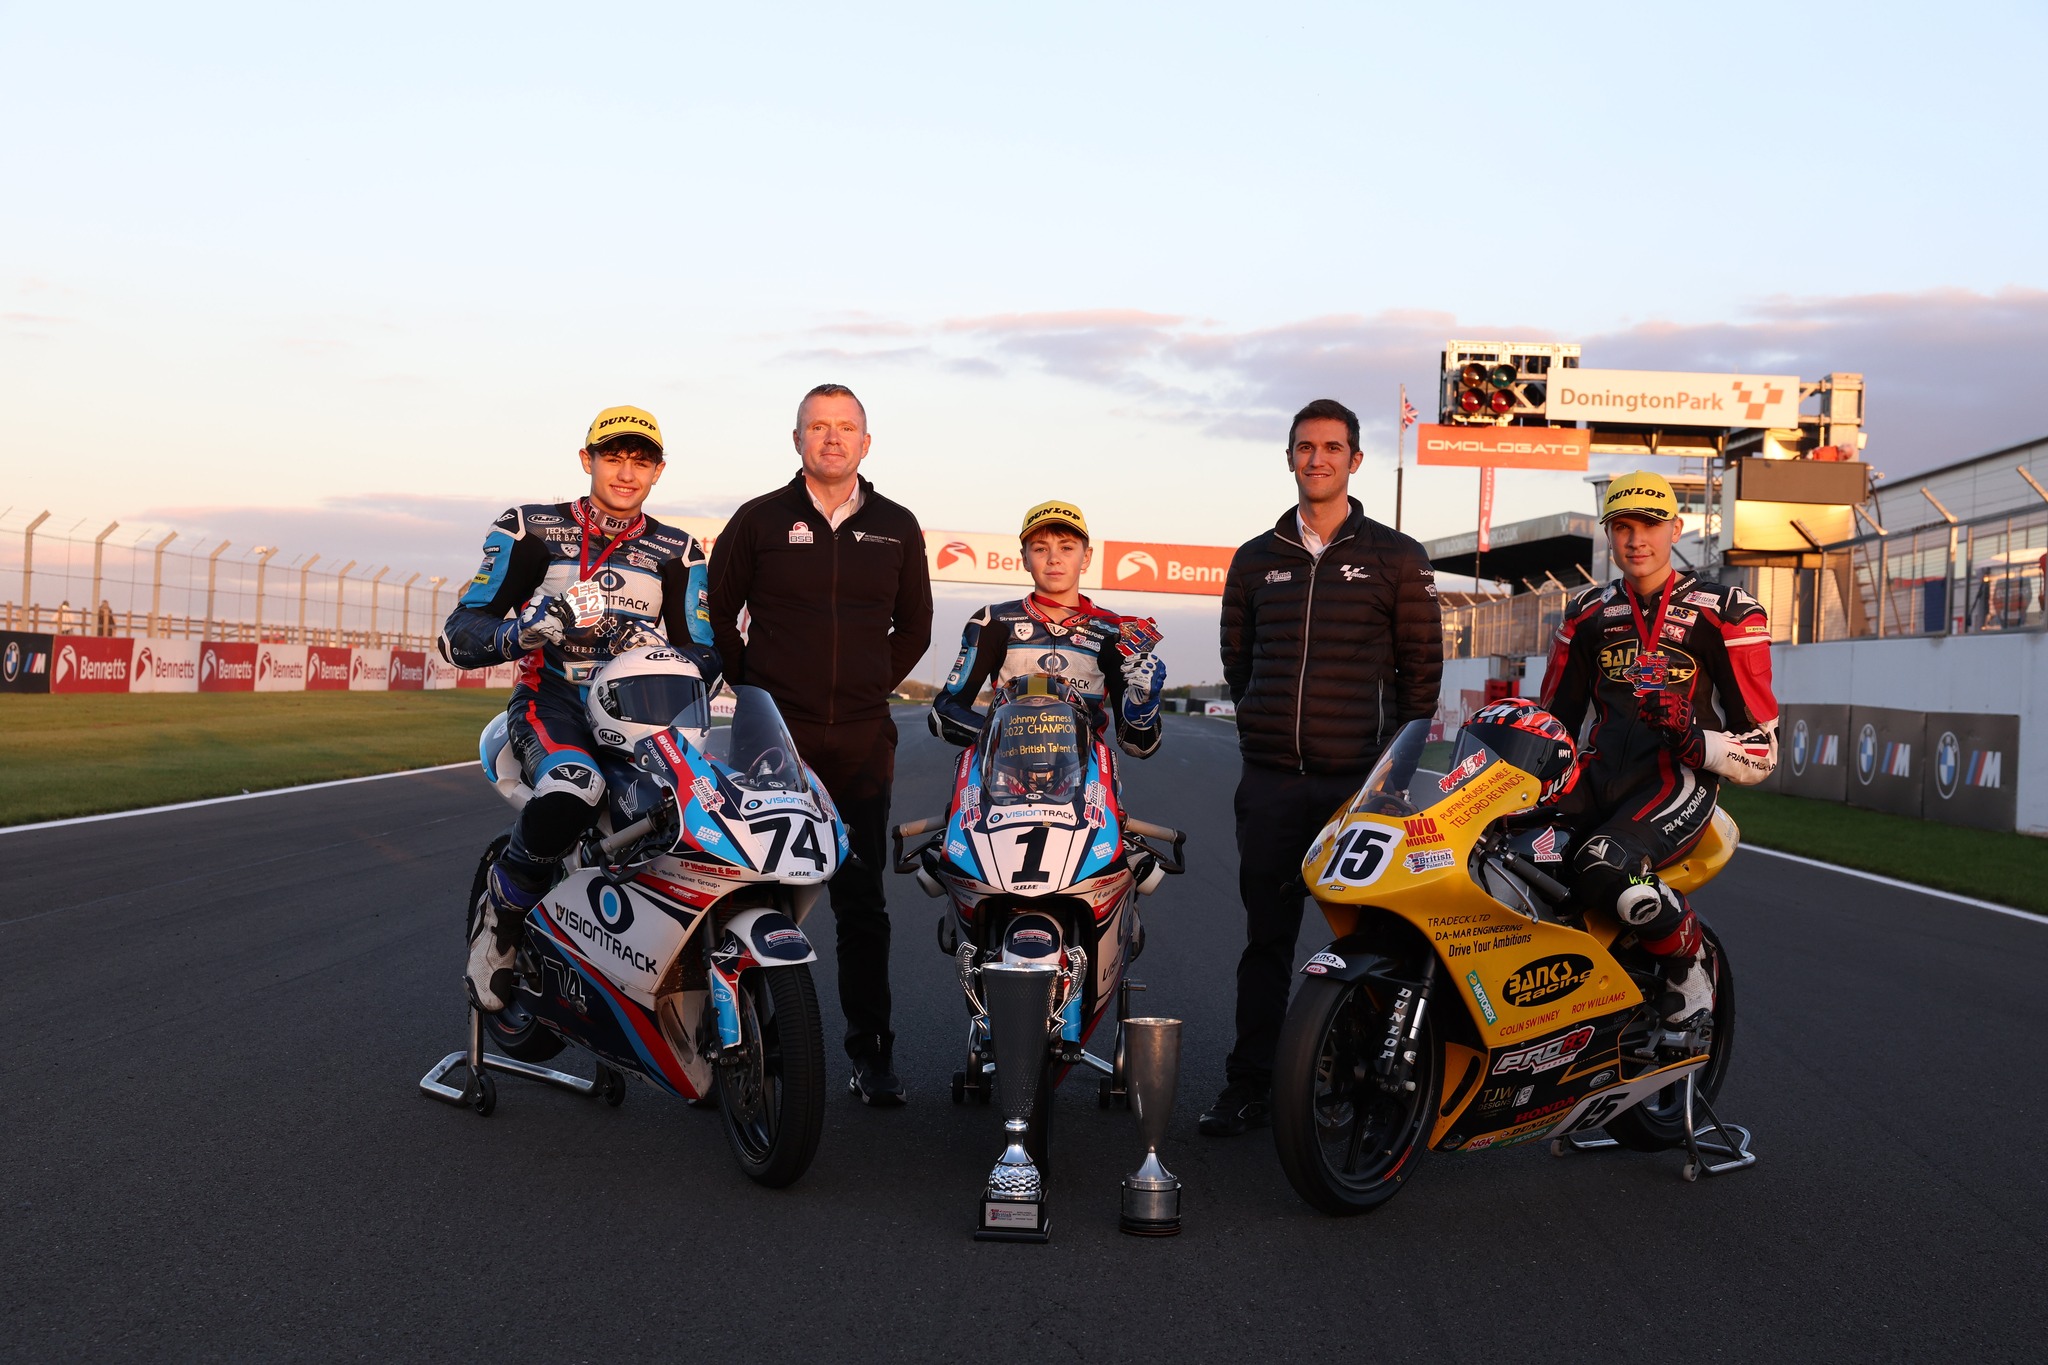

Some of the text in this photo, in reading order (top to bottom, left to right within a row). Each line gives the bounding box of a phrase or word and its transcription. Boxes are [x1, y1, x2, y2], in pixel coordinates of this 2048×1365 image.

[1560, 387, 1724, 412] DoningtonPark
[598, 415, 657, 431] DUNLOP
[1426, 438, 1581, 456] OMOLOGATO
[1606, 487, 1666, 504] DUNLOP
[1026, 507, 1081, 525] DUNLOP
[545, 534, 583, 542] AIR BAG
[648, 541, 672, 555] OXFORD
[1677, 577, 1697, 592] THOMAS
[588, 595, 600, 612] 2
[1667, 606, 1690, 619] J&S
[1083, 629, 1105, 640] OXFORD
[80, 656, 127, 680] Bennetts
[155, 657, 195, 680] Bennetts
[218, 658, 253, 680] Bennetts
[273, 659, 303, 679] Bennetts
[321, 661, 348, 681] Bennetts
[363, 662, 387, 681] Bennetts
[401, 664, 423, 681] Bennetts
[1008, 712, 1072, 726] Johnny Garness
[600, 732, 622, 743] HJC
[1003, 723, 1076, 738] 2022 CHAMPION
[644, 739, 668, 772] Streamax
[663, 742, 682, 764] OXFORD
[1020, 743, 1046, 755] British
[1047, 742, 1071, 754] Talent
[695, 778, 713, 801] British
[1440, 767, 1511, 821] PUFFIN CRUISES AMBLE
[764, 796, 819, 814] VISIONTRACK
[1450, 773, 1525, 829] TELFORD REWINDS
[1681, 785, 1707, 820] THOMAS
[1005, 809, 1074, 821] VISIONTRACK
[696, 830, 721, 843] DICK
[699, 825, 723, 838] KING
[1403, 817, 1437, 838] WU
[749, 816, 828, 875] 74
[951, 839, 967, 851] KING
[1092, 842, 1111, 851] KING
[1405, 833, 1446, 848] MUNSON
[948, 844, 964, 856] DICK
[1011, 826, 1050, 884] 1
[1095, 847, 1114, 858] DICK
[1322, 828, 1393, 880] 15
[1419, 852, 1452, 864] British
[1535, 853, 1562, 863] HONDA
[690, 862, 717, 873] Walton
[725, 868, 741, 876] Son
[1426, 860, 1455, 869] Talent Cup
[1428, 914, 1491, 928] TRADECK LTD
[555, 901, 658, 976] VISIONTRACK
[1435, 924, 1524, 941] DA-MAR ENGINEERING
[1448, 933, 1532, 958] Drive Your Ambitions
[1509, 960, 1573, 996] BANKS
[1515, 969, 1593, 1006] Racing
[1472, 983, 1497, 1023] MOTOREX
[1571, 991, 1627, 1014] ROY WILLIAMS
[1380, 987, 1412, 1059] DUNLOP
[1499, 1009, 1561, 1037] COLIN SWINNEY
[1536, 1055, 1575, 1072] ACADEMY
[1482, 1084, 1518, 1103] TJW
[1477, 1098, 1512, 1112] DESIGNS
[1514, 1096, 1576, 1124] HONDA
[1511, 1112, 1564, 1136] DUNLOP
[1469, 1136, 1495, 1149] NGK
